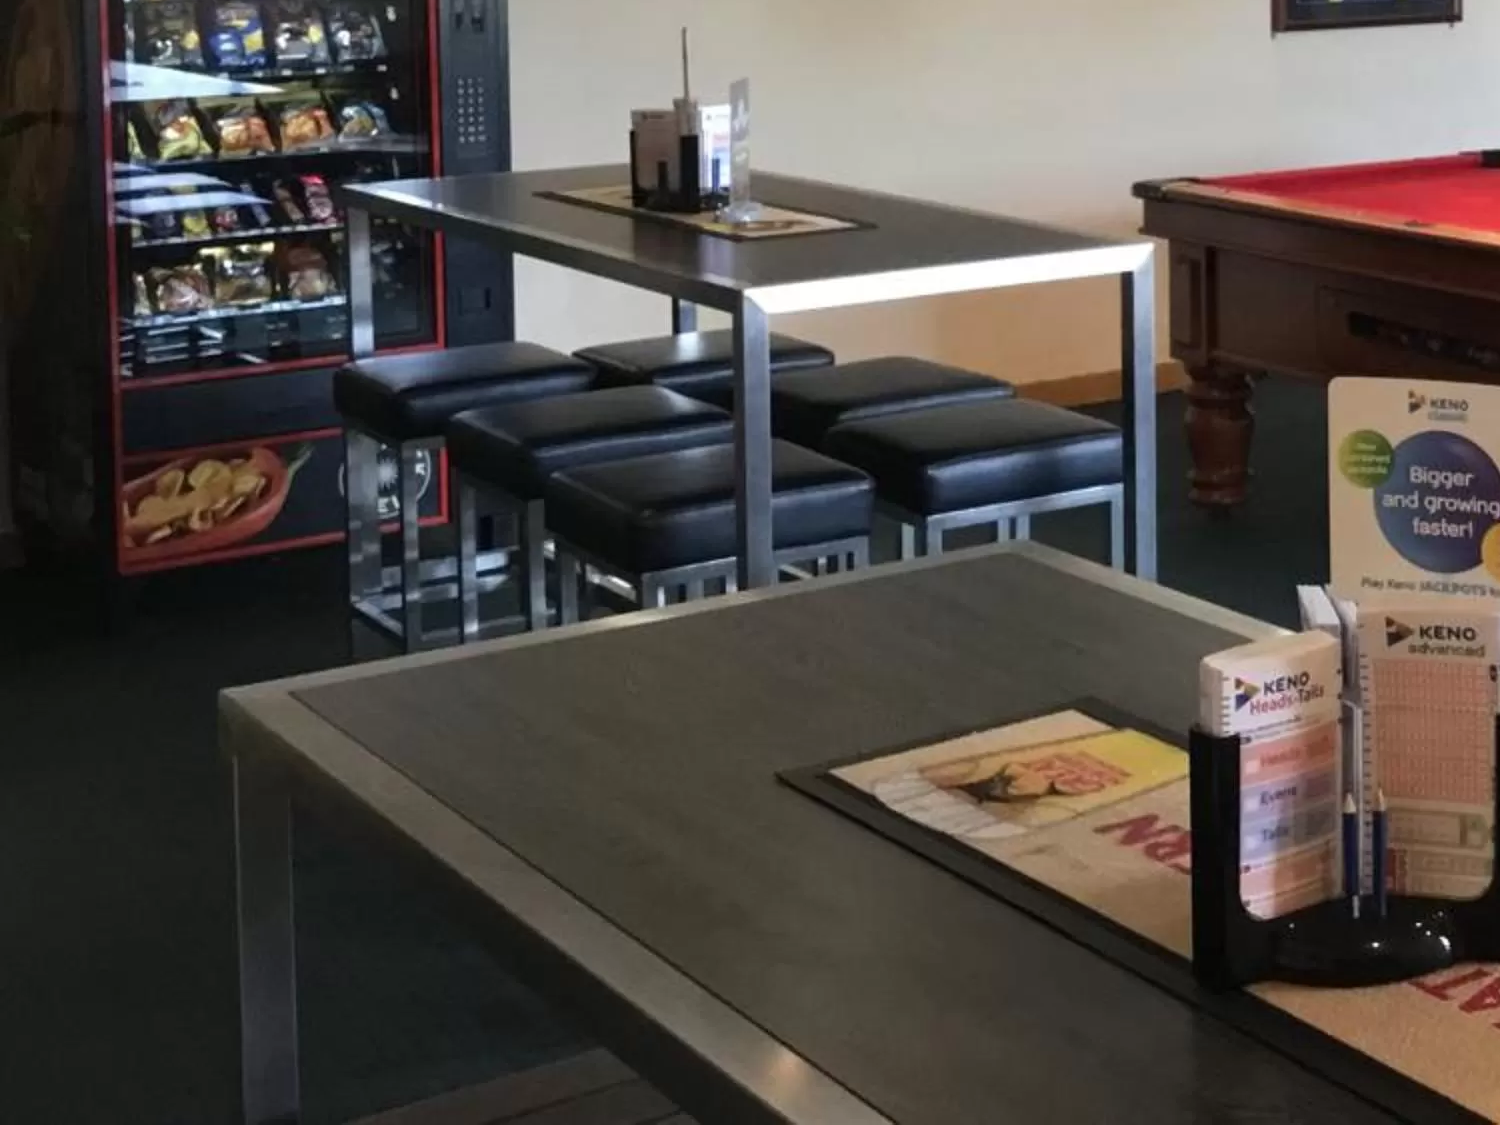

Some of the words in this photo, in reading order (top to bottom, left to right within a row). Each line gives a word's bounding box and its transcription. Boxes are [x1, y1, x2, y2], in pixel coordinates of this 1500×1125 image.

[1429, 398, 1469, 412] KENO
[1409, 465, 1474, 490] Bigger
[1382, 491, 1419, 508] and
[1423, 495, 1500, 518] growing
[1412, 517, 1473, 539] faster!
[1419, 625, 1477, 642] KENO
[1408, 643, 1486, 658] advanced
[1263, 671, 1311, 695] KENO
